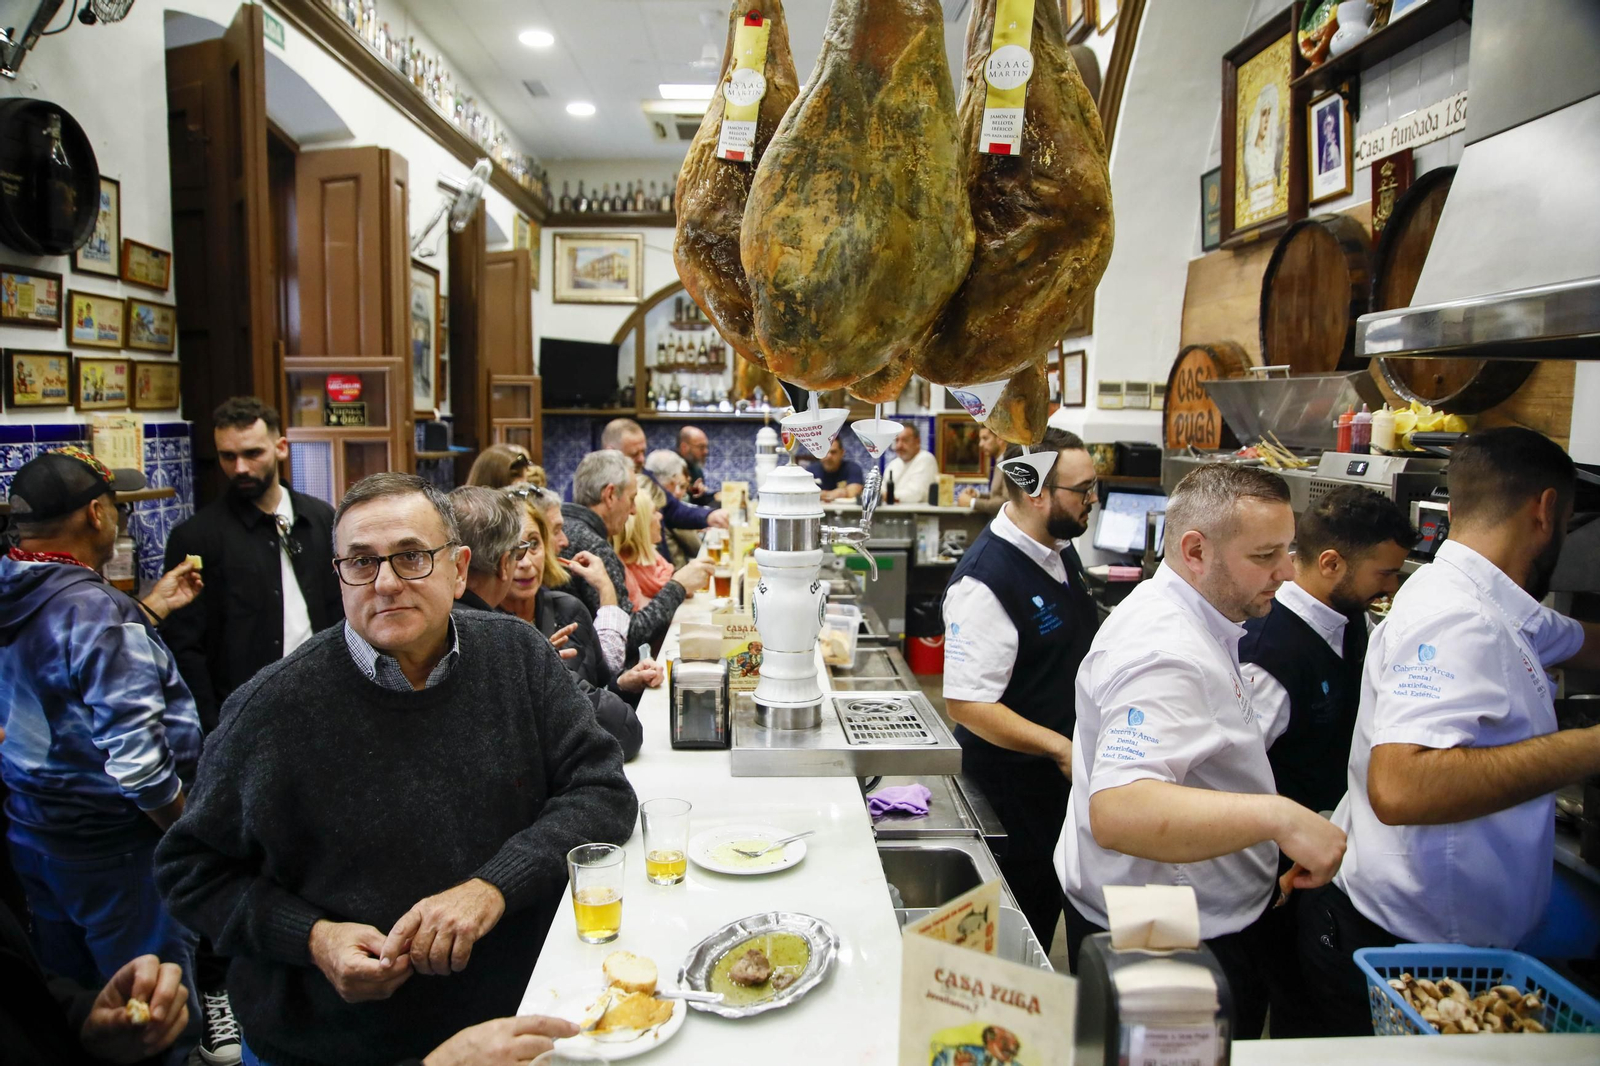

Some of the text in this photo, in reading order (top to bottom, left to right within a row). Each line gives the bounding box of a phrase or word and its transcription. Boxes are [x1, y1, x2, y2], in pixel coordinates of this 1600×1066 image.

[989, 60, 1030, 69] ISAAC
[728, 81, 763, 89] ISAAC
[1358, 137, 1385, 160] Casa
[1174, 408, 1215, 445] PUGA
[1392, 664, 1423, 673] Cabrera
[1430, 666, 1455, 680] Arcas
[1408, 673, 1432, 682] Dental
[1106, 727, 1131, 736] Cabrera
[1137, 732, 1160, 744] Arcas
[1117, 737, 1139, 747] Dental
[934, 967, 1042, 1015] CASA PUGA
